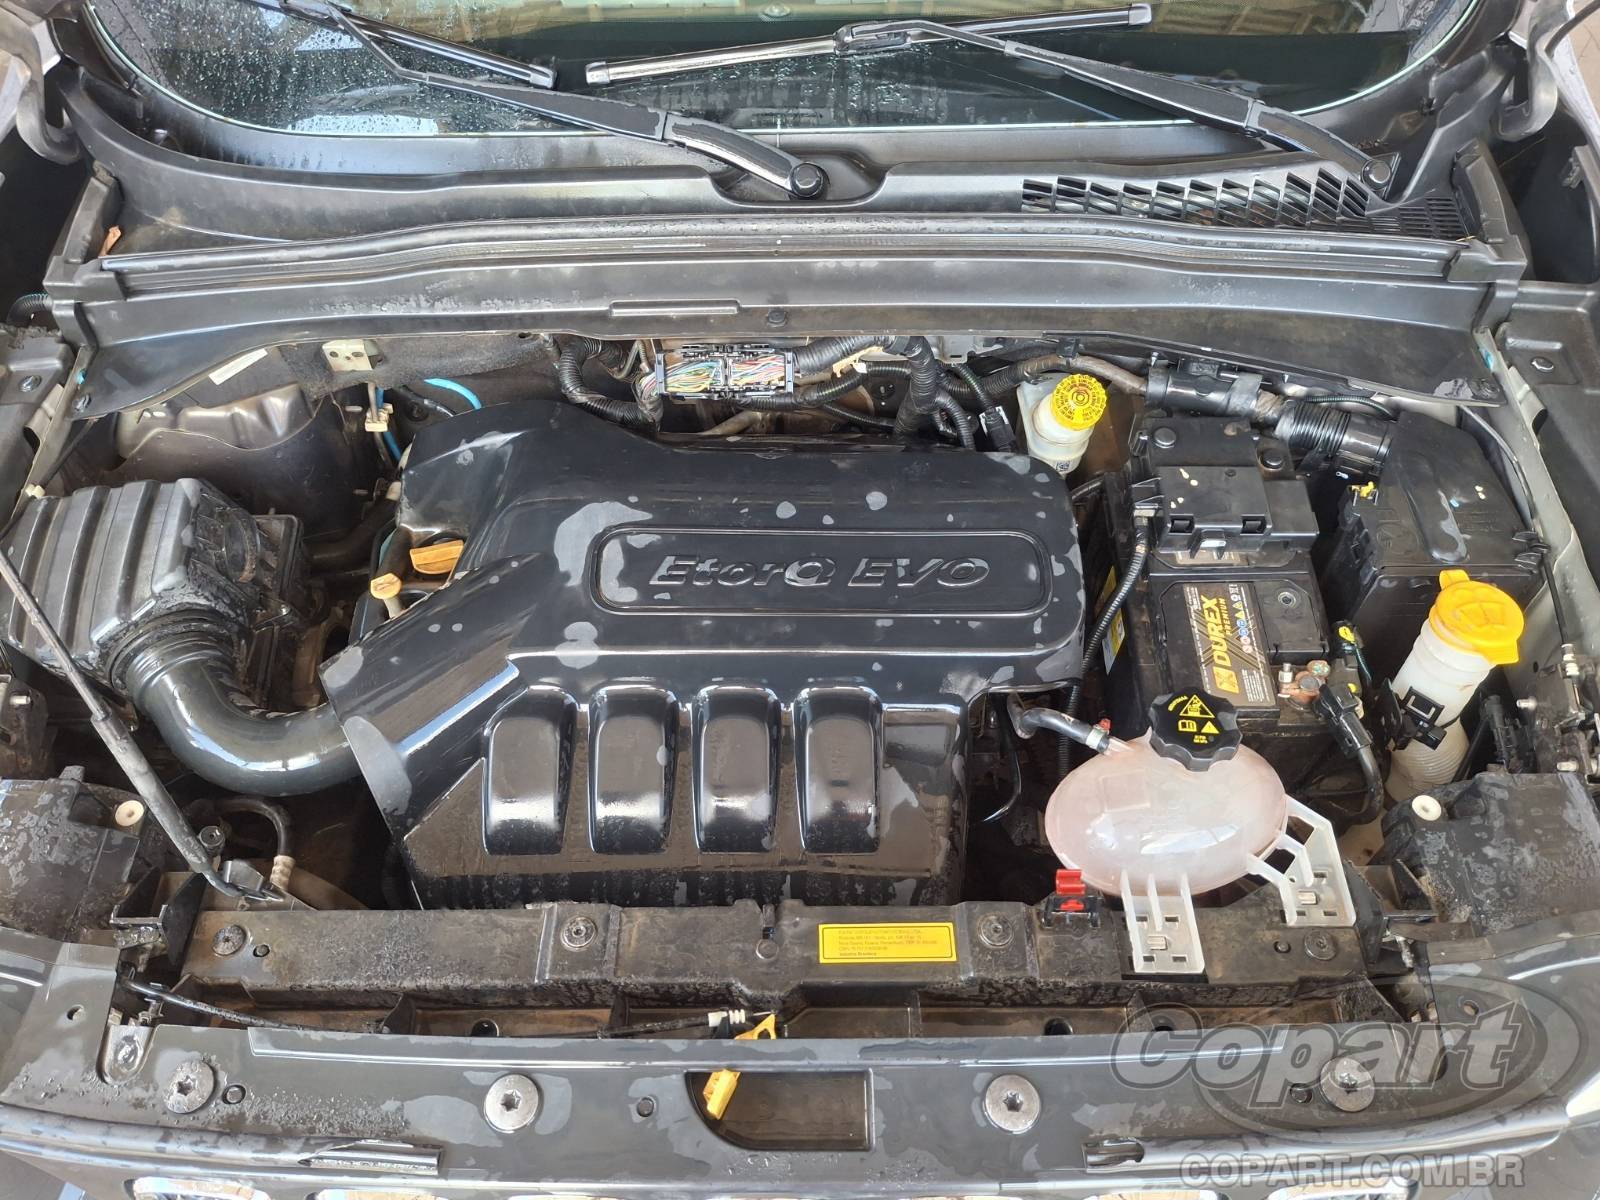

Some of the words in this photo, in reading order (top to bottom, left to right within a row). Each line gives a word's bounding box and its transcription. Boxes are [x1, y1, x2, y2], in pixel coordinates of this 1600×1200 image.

[847, 556, 991, 587] EVO
[1200, 594, 1232, 667] DUREX
[1218, 597, 1233, 637] PREMIUM
